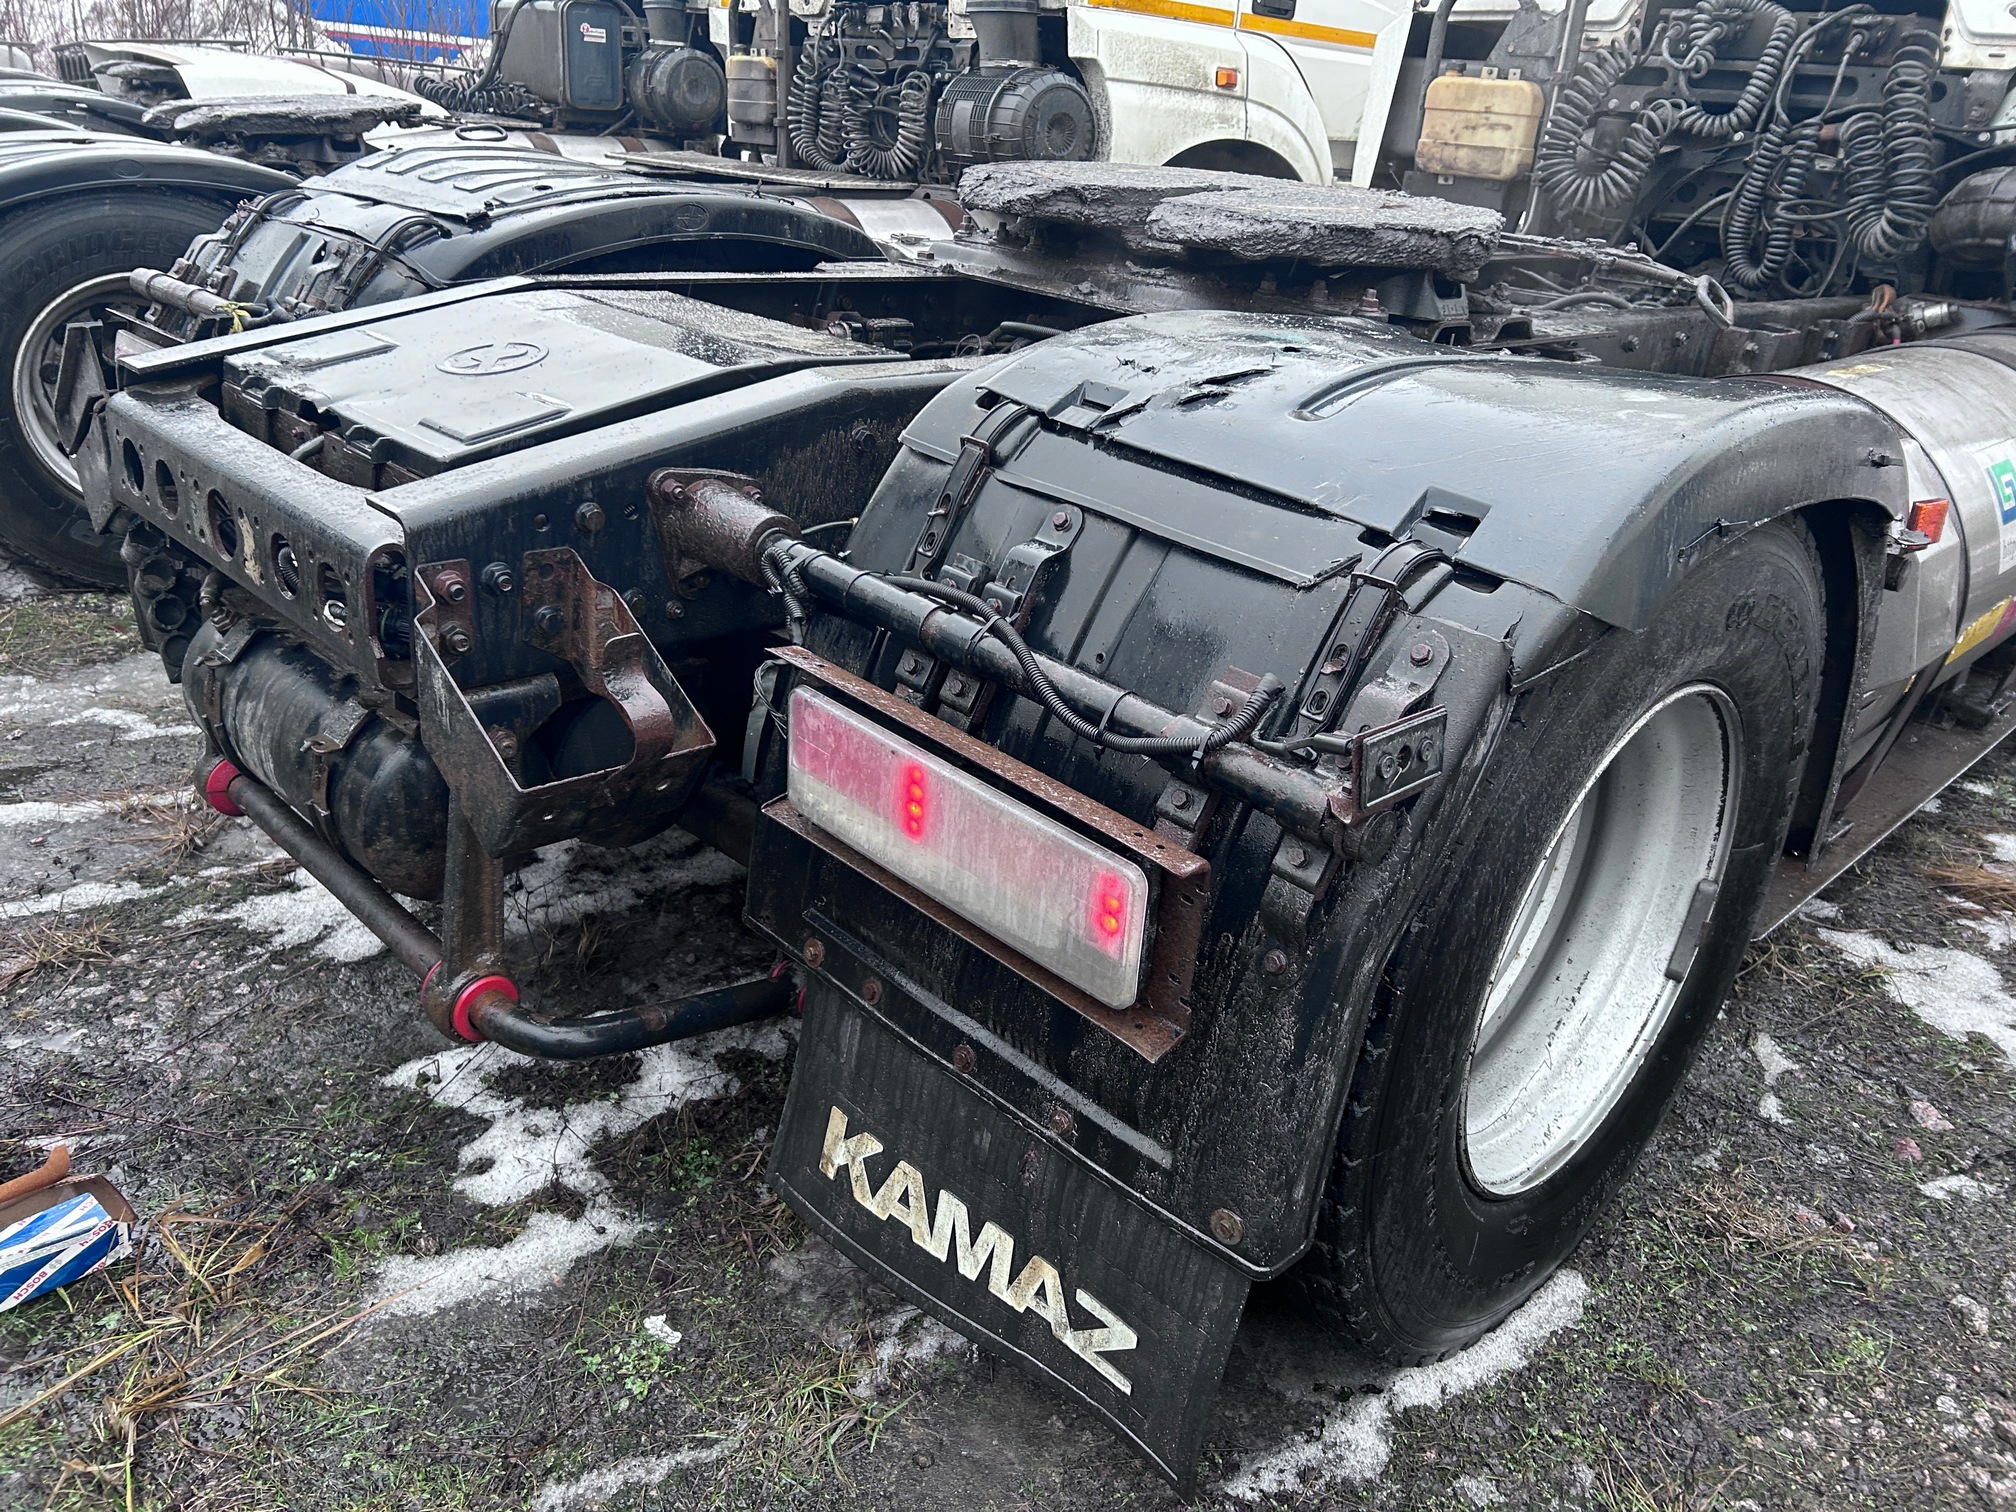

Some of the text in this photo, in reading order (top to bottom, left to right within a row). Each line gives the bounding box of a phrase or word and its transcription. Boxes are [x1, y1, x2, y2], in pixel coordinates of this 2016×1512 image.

[13, 228, 187, 293] BRIDGES
[819, 1105, 1138, 1396] KAMAZ
[13, 1270, 48, 1301] BOSCH
